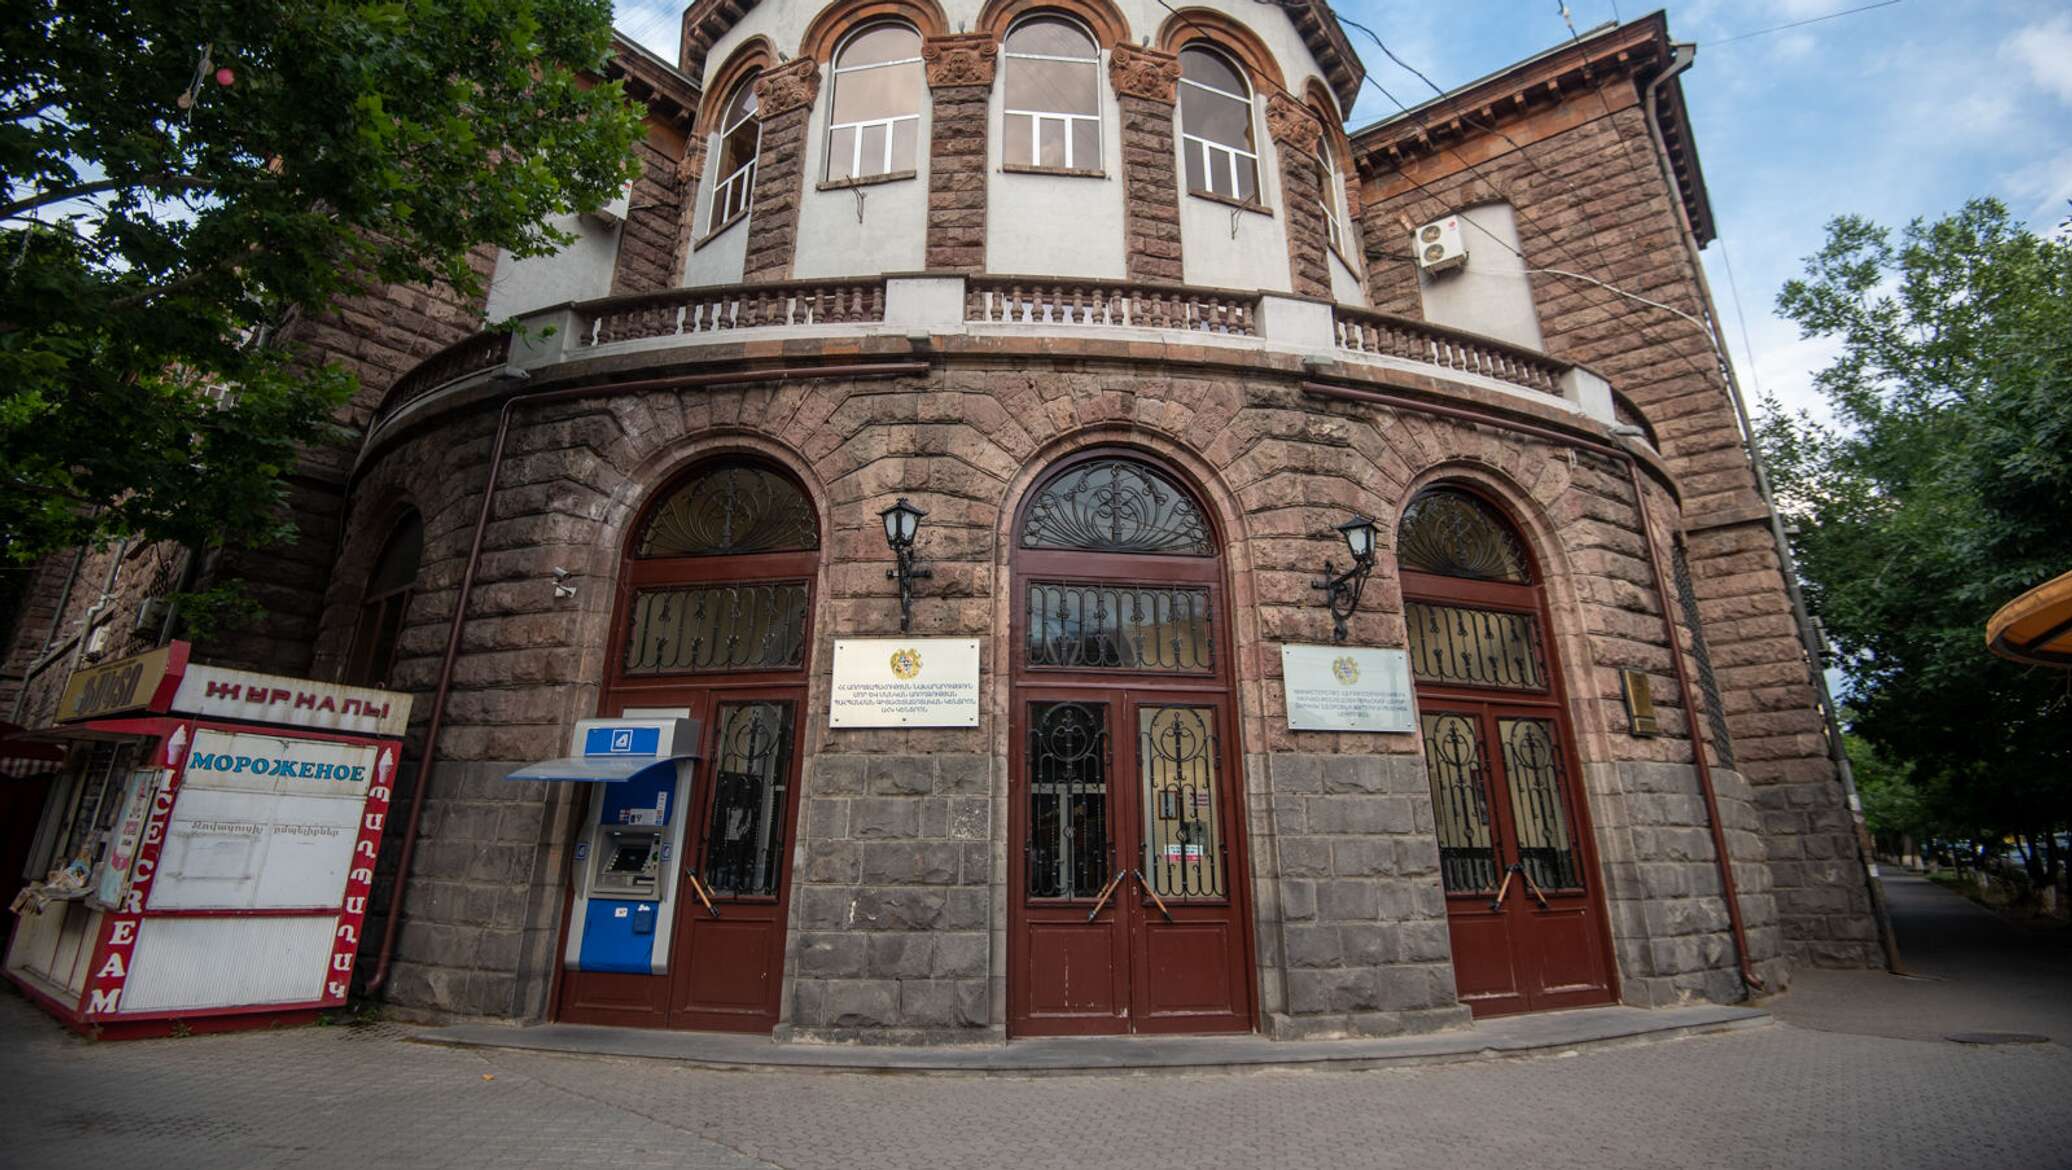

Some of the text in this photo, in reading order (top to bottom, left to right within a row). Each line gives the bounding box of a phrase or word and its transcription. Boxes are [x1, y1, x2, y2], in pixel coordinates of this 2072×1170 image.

[205, 680, 390, 719] ЖУРНАЛЫ
[189, 752, 366, 781] МОРОЖЕНОЕ
[86, 858, 154, 1015] CREAM
